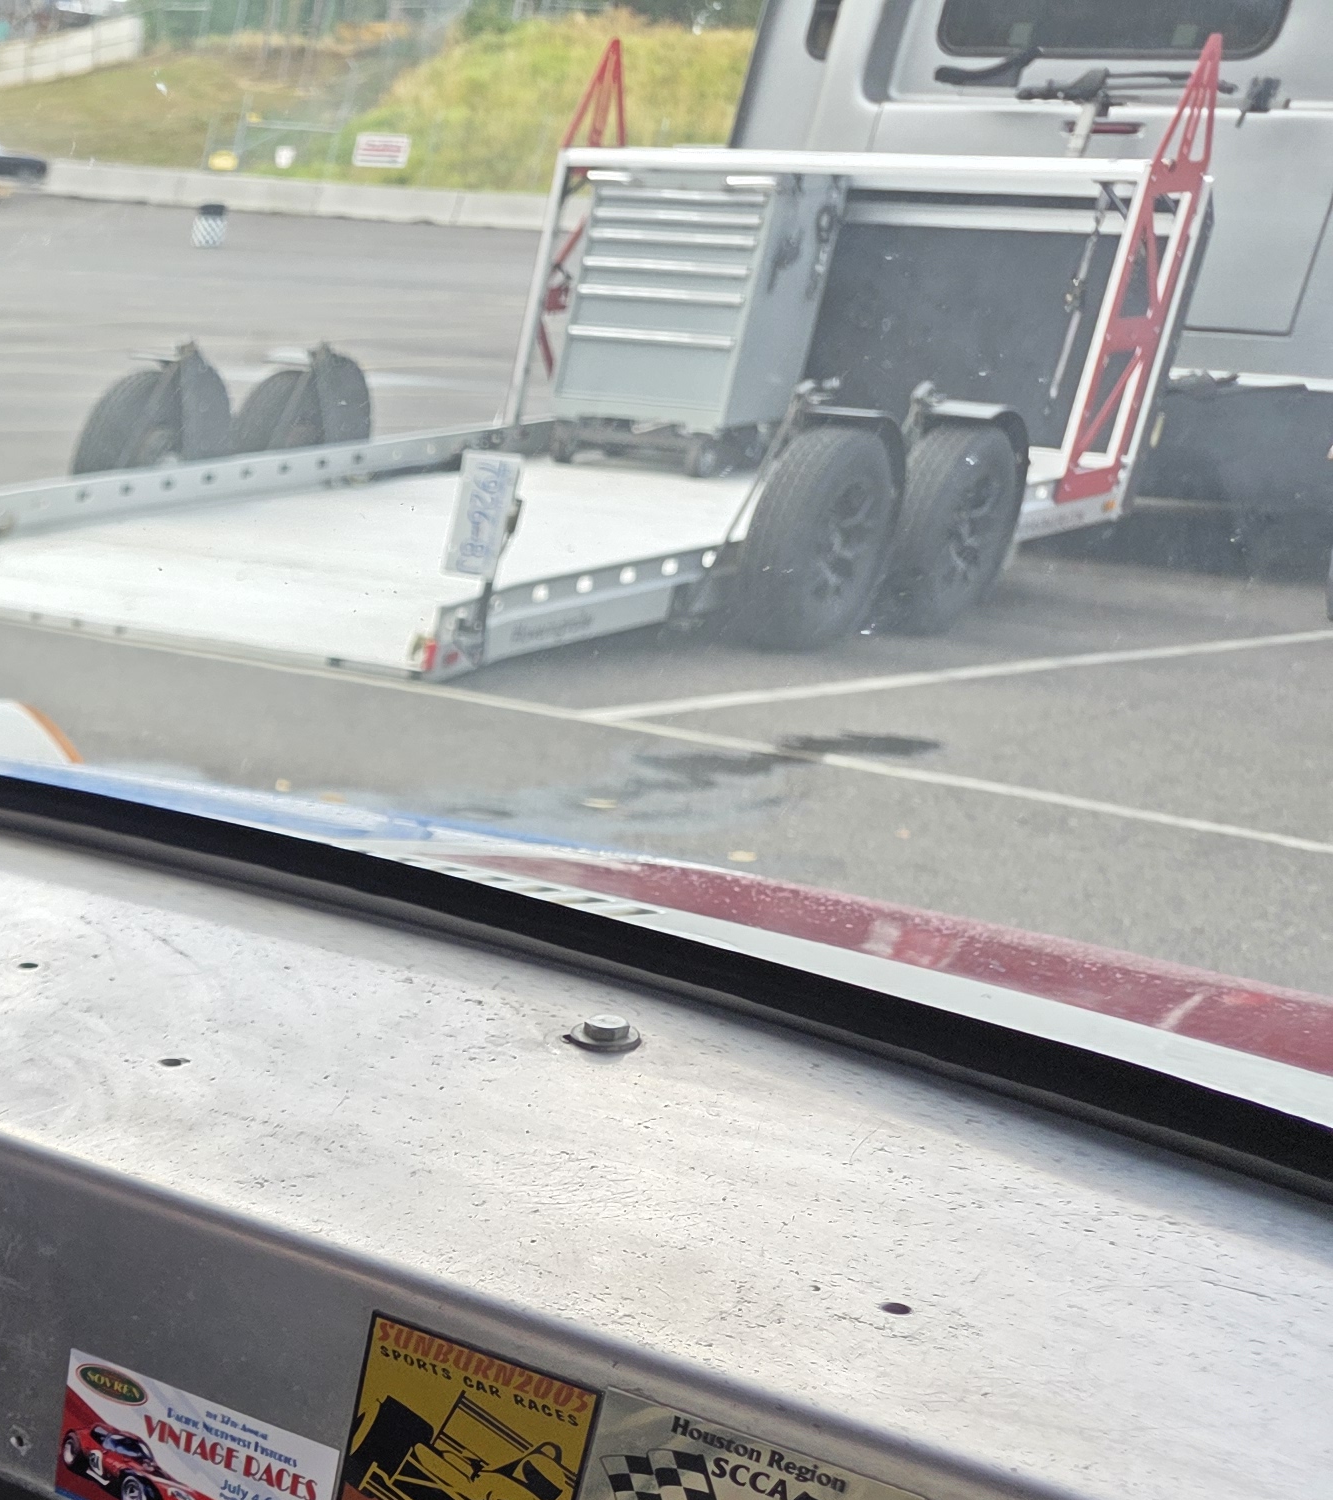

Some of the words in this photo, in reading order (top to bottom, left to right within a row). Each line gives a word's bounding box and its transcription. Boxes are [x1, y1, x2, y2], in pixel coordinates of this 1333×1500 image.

[86, 1370, 140, 1400] SOVREN
[379, 1345, 453, 1381] SPORTS
[462, 1375, 502, 1399] CAR
[513, 1392, 579, 1427] RACES
[144, 1414, 240, 1473] VINTAGE
[671, 1415, 762, 1464] Houston
[766, 1449, 848, 1494] Region
[221, 1479, 249, 1500] July
